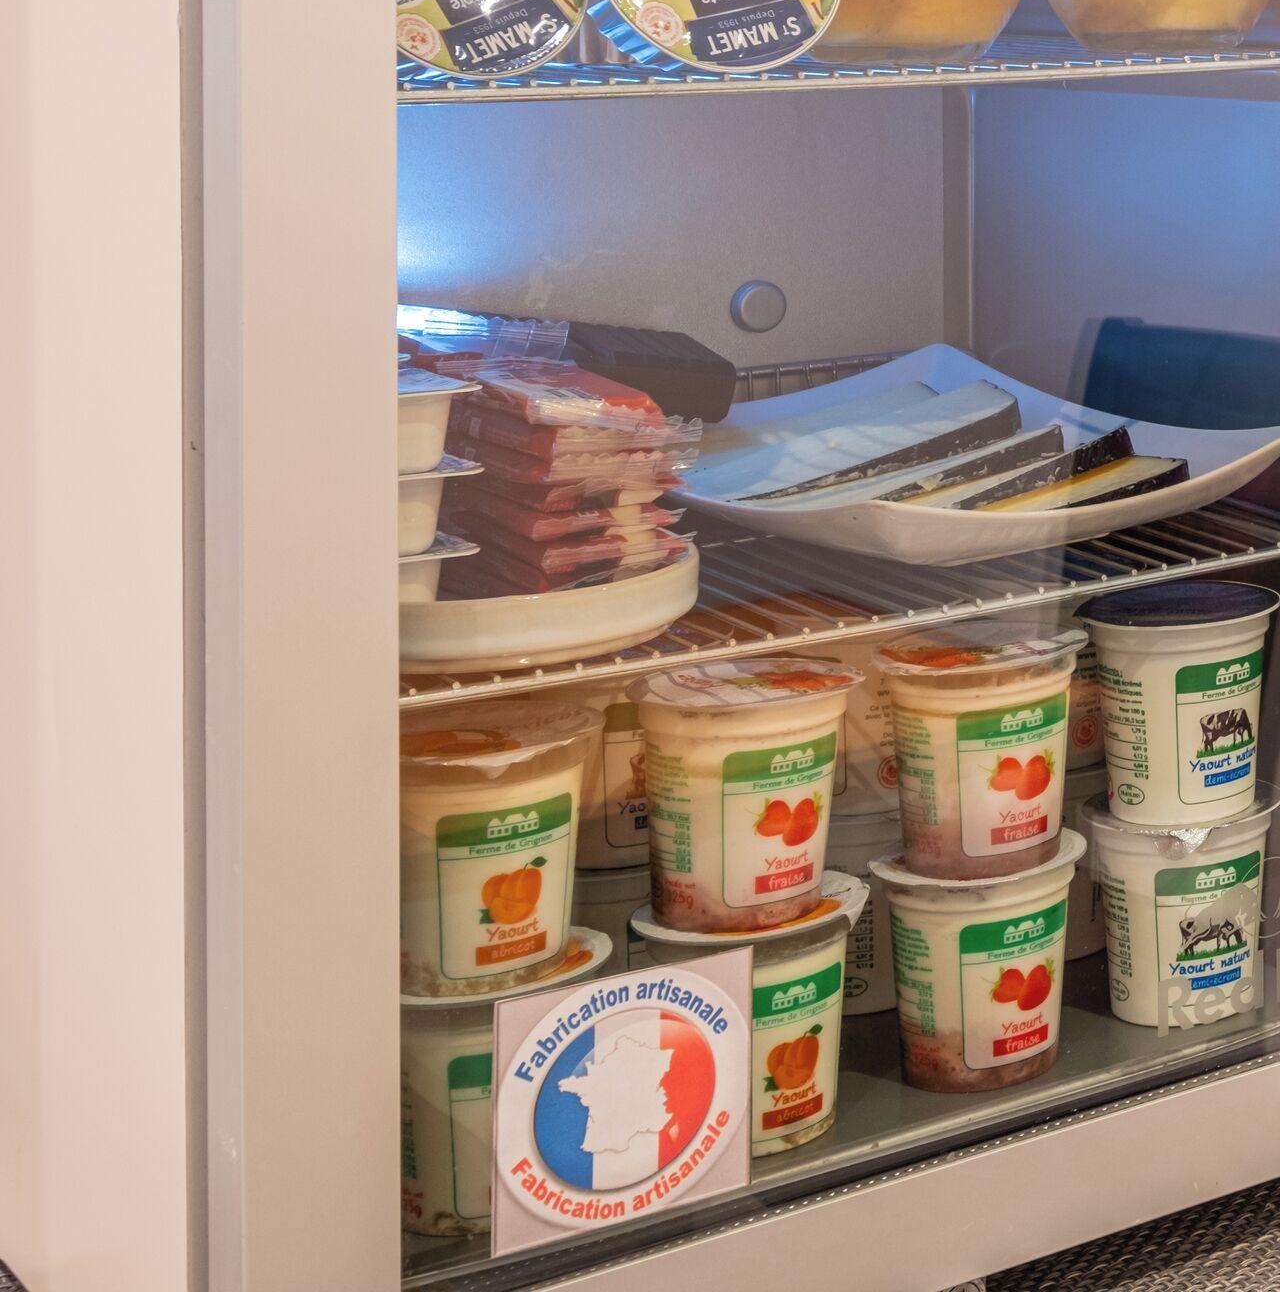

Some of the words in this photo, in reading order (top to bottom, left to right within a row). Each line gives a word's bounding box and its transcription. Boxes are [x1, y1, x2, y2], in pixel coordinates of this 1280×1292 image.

[717, 17, 740, 29] 1953
[743, 9, 775, 23] Depuis
[465, 20, 537, 64] MAMET
[709, 22, 780, 56] MAMET
[1201, 690, 1226, 700] Ferme
[1228, 687, 1237, 696] de
[984, 738, 1013, 748] Ferme
[1015, 734, 1026, 744] de
[1189, 755, 1231, 773] Yaourt
[752, 778, 782, 791] Ferme
[785, 774, 796, 786] de
[1000, 803, 1043, 824] Yaourt
[1004, 822, 1040, 841] fraise
[468, 844, 501, 856] Ferme
[504, 840, 517, 852] de
[519, 832, 554, 849] Grignon
[764, 849, 810, 871] Yaourt
[768, 871, 807, 891] fraise
[486, 917, 540, 942] Yaourt
[491, 938, 536, 959] abricot
[987, 950, 1015, 960] Ferme
[1017, 945, 1028, 955] de
[1169, 962, 1215, 977] Yaourt
[1221, 948, 1251, 969] nature
[1157, 950, 1264, 1038] Red
[755, 1016, 785, 1029] Ferme
[787, 1010, 798, 1022] de
[1002, 1014, 1044, 1036] Yaourt
[513, 984, 630, 1083] Fabrication
[635, 978, 729, 1035] artisanale
[1006, 1033, 1041, 1054] fraise
[771, 1081, 818, 1108] Yaourt
[776, 1101, 816, 1123] abricot
[510, 1156, 626, 1221] Fabrication
[632, 1109, 731, 1213] artisanale
